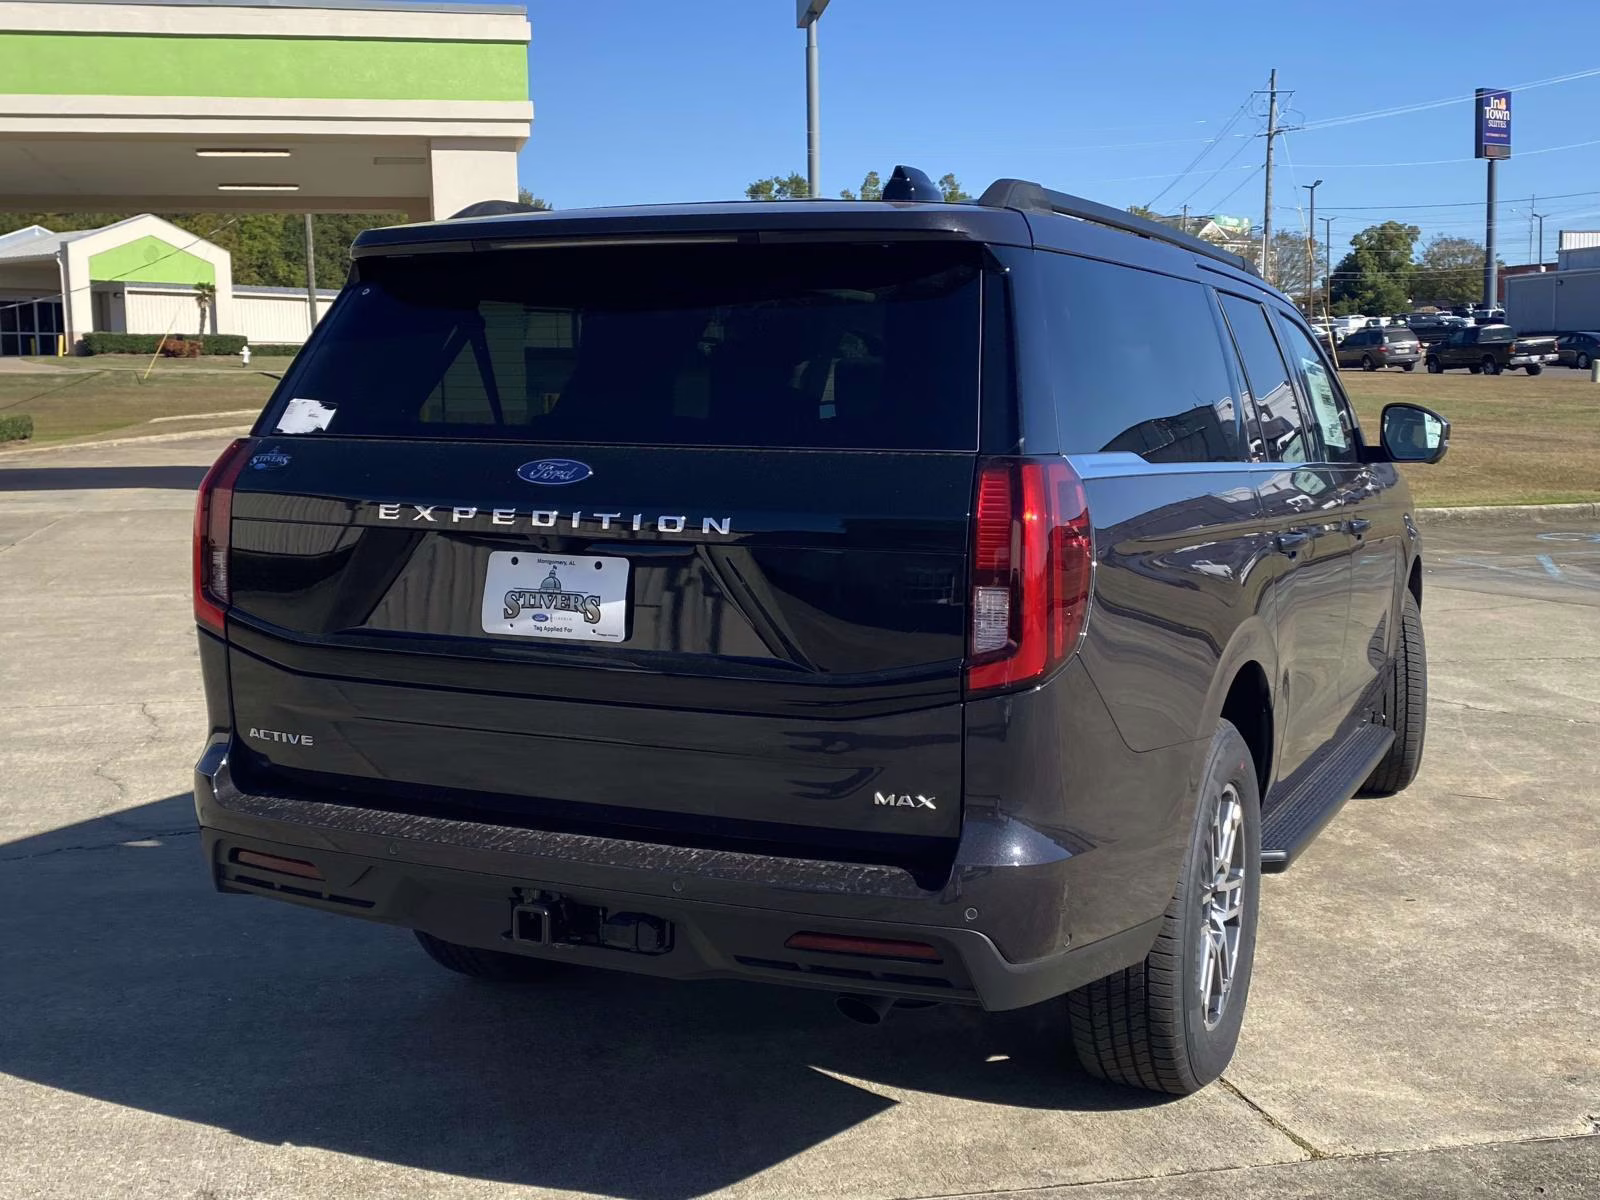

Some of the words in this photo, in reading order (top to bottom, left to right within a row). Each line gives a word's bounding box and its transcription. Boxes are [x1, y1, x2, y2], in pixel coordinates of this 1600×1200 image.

[1484, 106, 1510, 120] Town
[529, 461, 578, 480] Ford
[378, 503, 732, 535] EXPEDITION
[503, 590, 601, 624] STIVERS
[249, 727, 314, 746] ACTIVE
[874, 791, 937, 810] MAX
